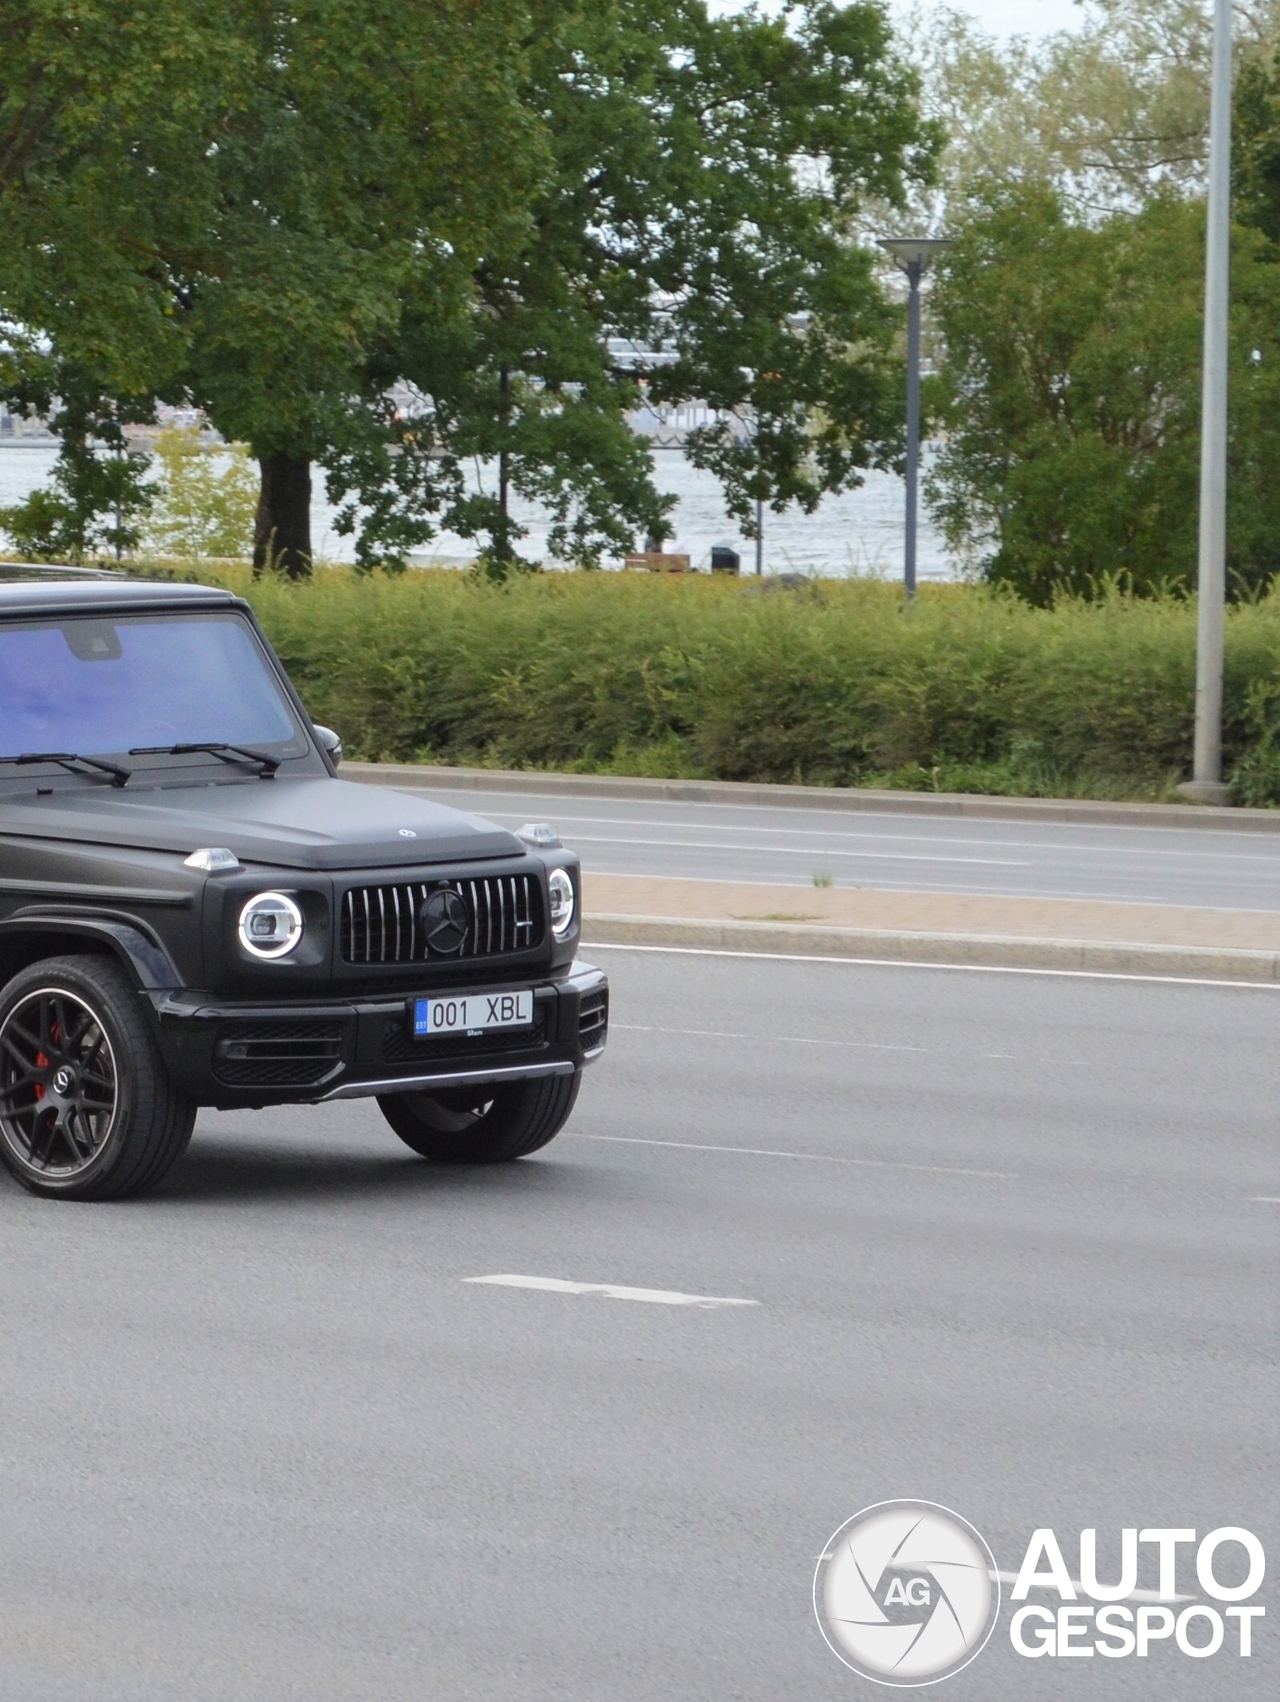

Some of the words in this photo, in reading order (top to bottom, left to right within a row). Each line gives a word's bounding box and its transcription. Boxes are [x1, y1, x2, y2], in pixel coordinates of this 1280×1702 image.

[433, 1000, 467, 1028] 001
[486, 995, 527, 1023] XBL
[415, 1021, 427, 1030] EST
